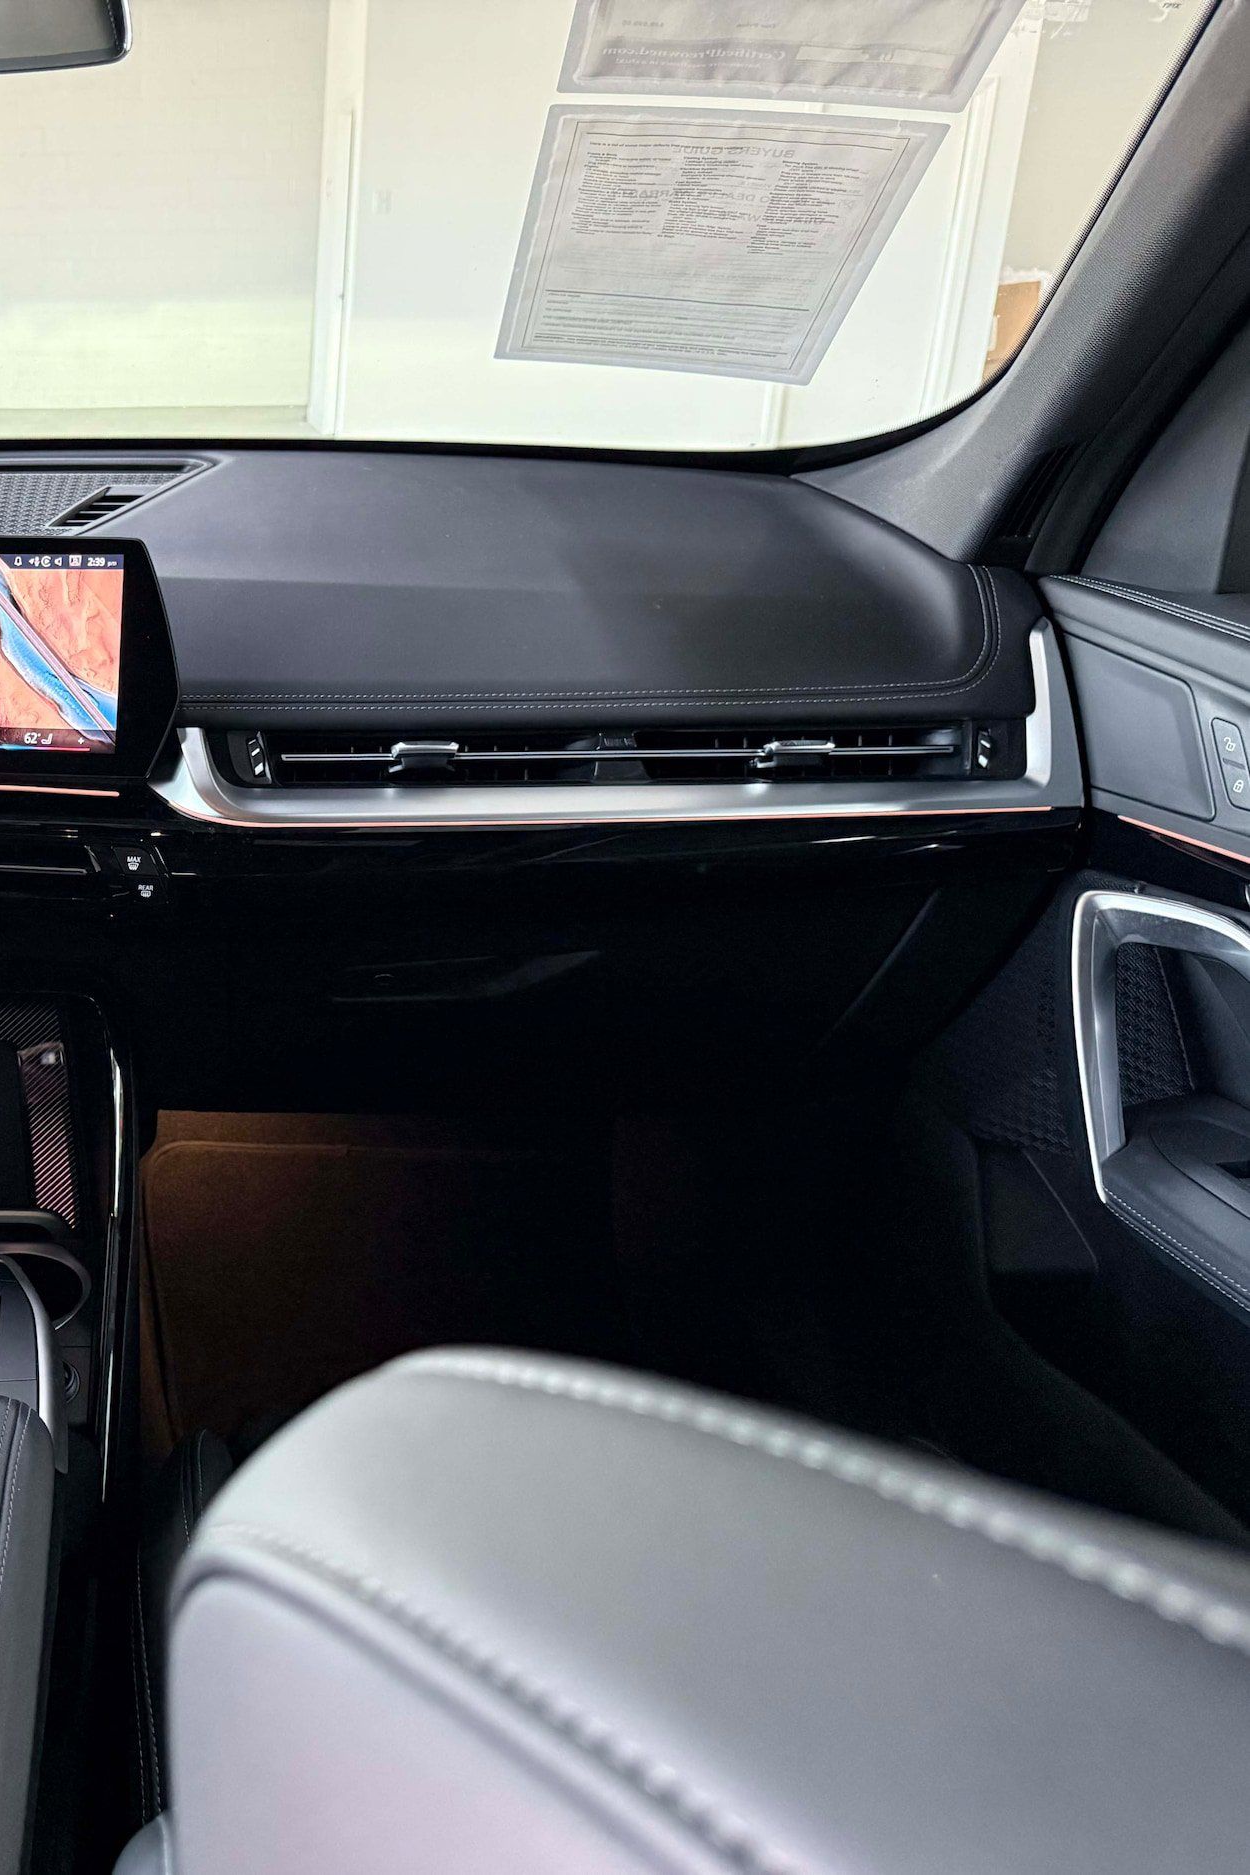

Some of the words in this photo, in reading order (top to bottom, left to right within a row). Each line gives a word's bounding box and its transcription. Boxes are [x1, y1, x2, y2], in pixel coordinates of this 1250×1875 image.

[87, 557, 105, 567] 2:39
[126, 856, 142, 864] MAX
[137, 884, 154, 892] REAR
